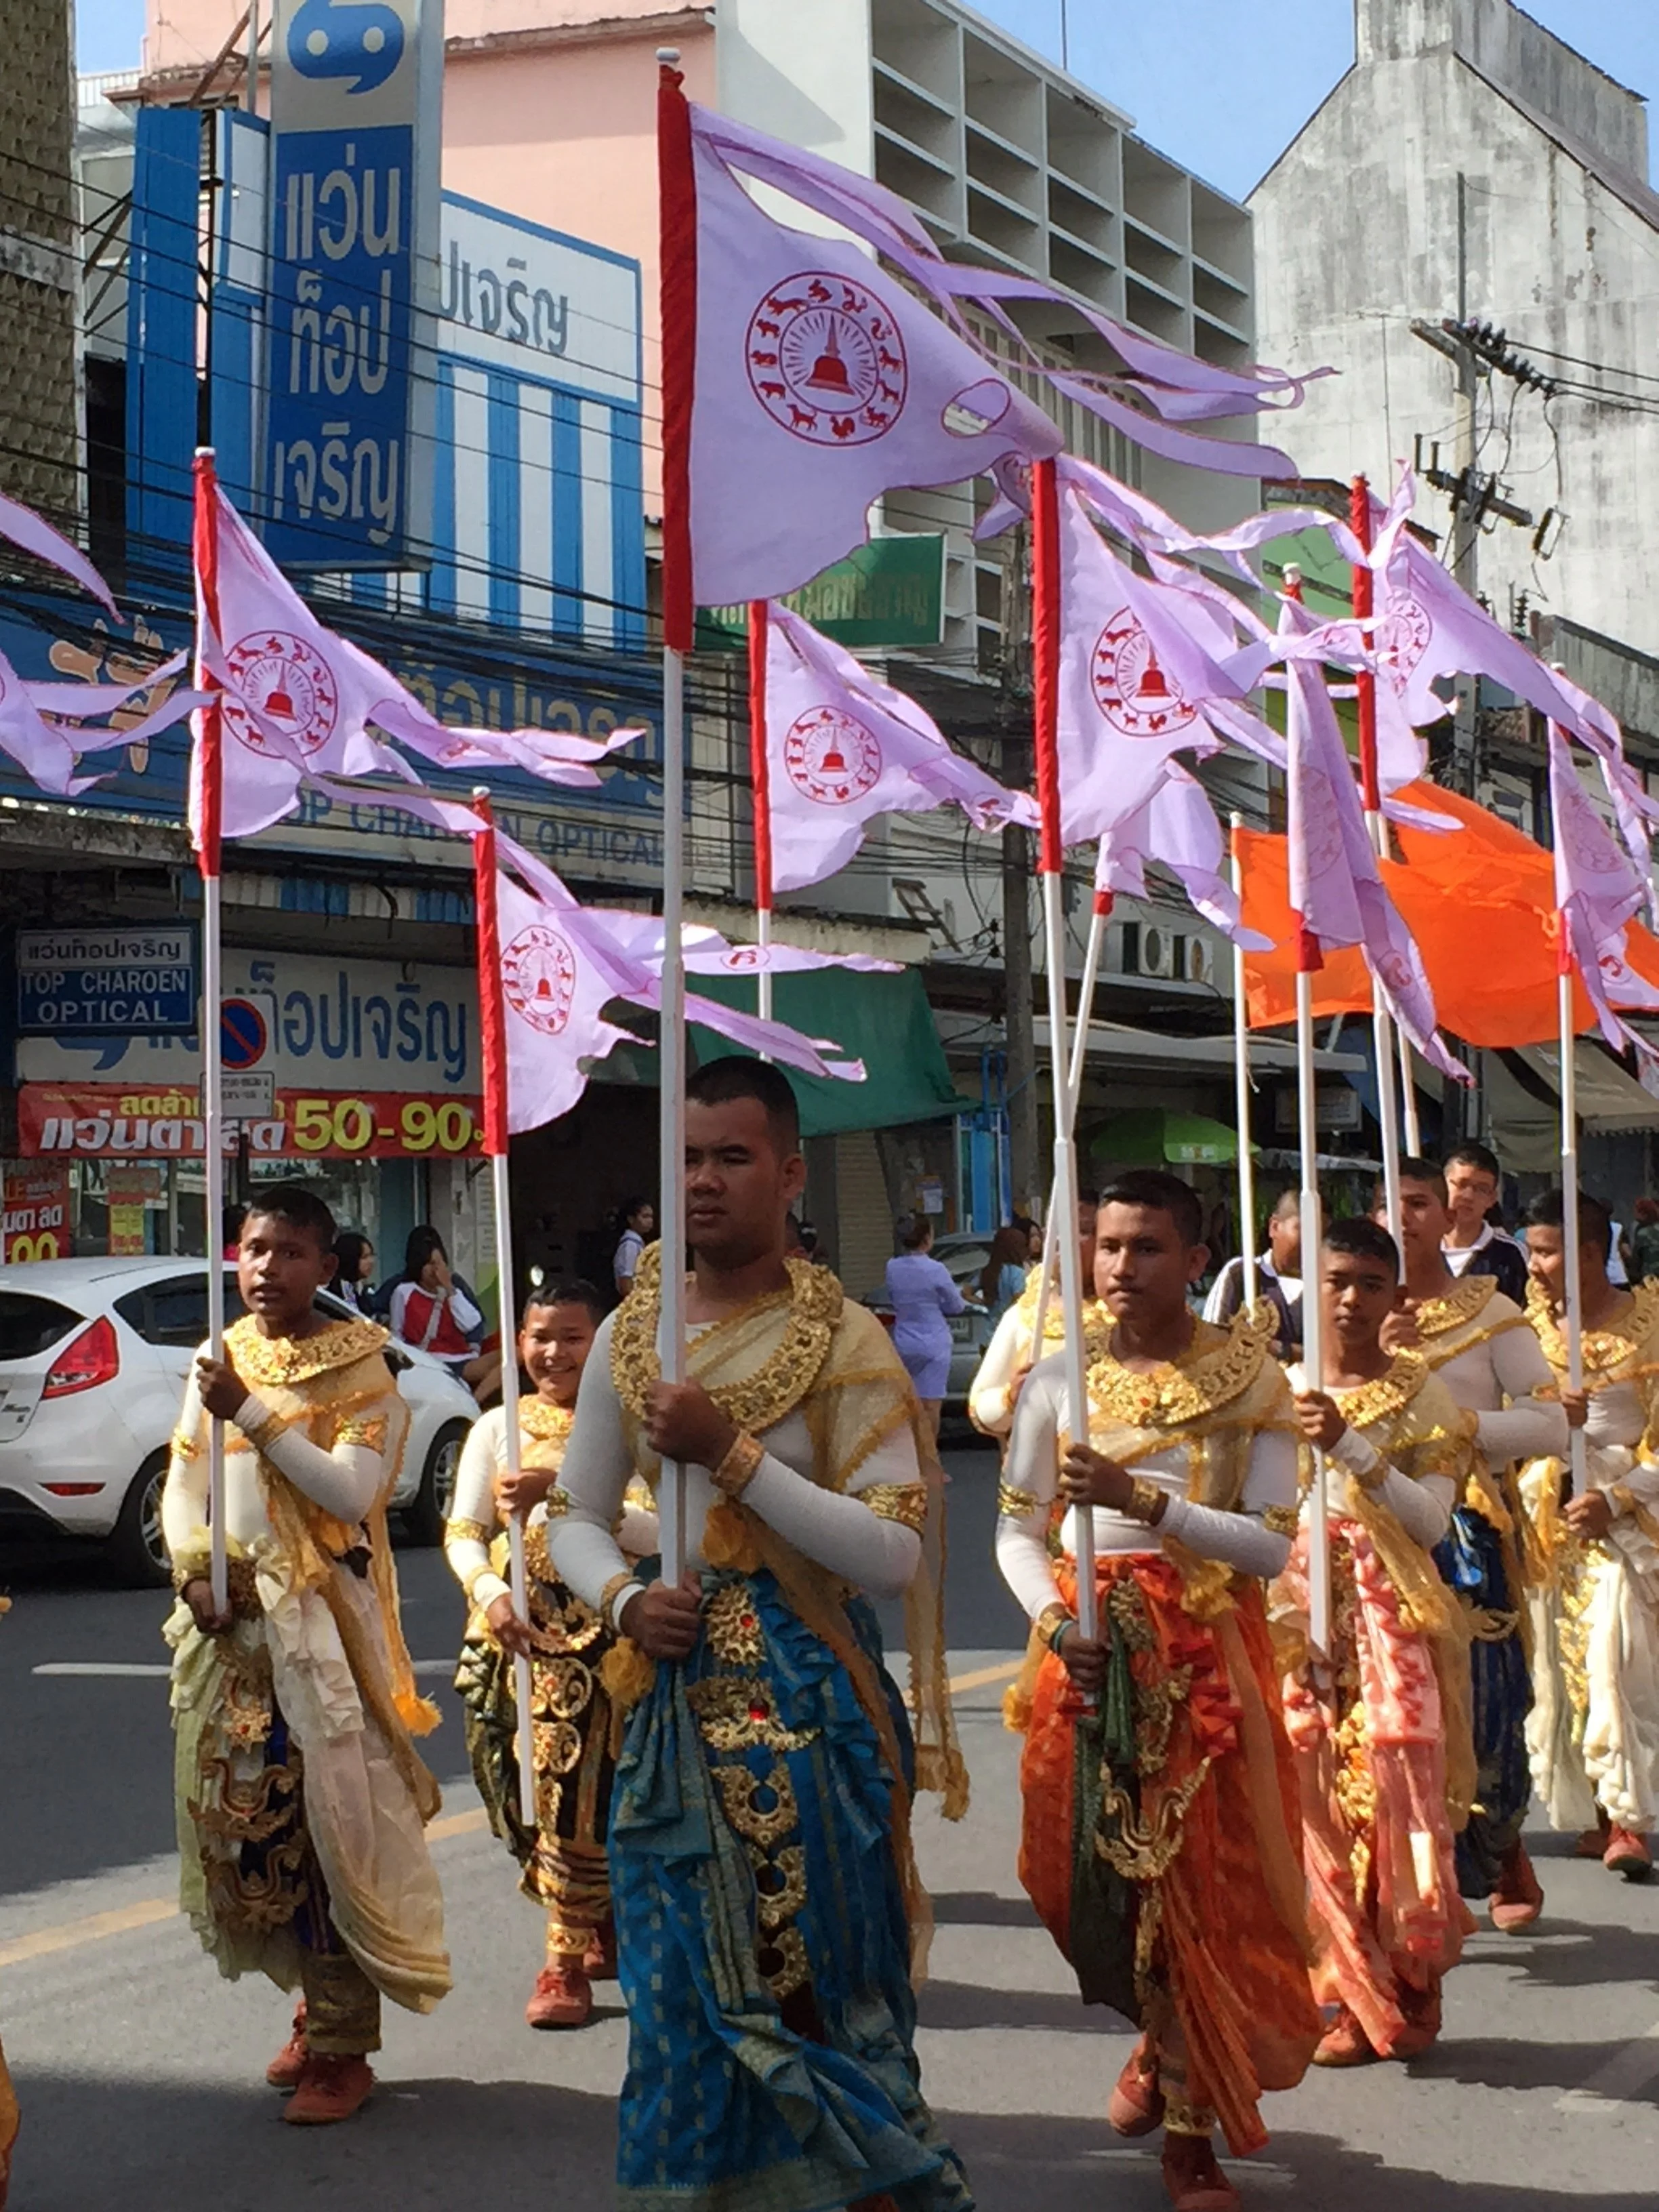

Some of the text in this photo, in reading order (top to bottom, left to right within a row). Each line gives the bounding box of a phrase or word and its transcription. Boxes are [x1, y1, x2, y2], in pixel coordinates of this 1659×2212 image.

[285, 144, 401, 261] แว่น
[290, 269, 391, 395] ท็อป
[438, 239, 568, 354] ปเจริญ
[273, 422, 399, 543] เจริญ
[21, 970, 186, 994] TOP CHAROEN
[37, 1000, 169, 1023] OPTICAL
[293, 1099, 483, 1151] 50-90
